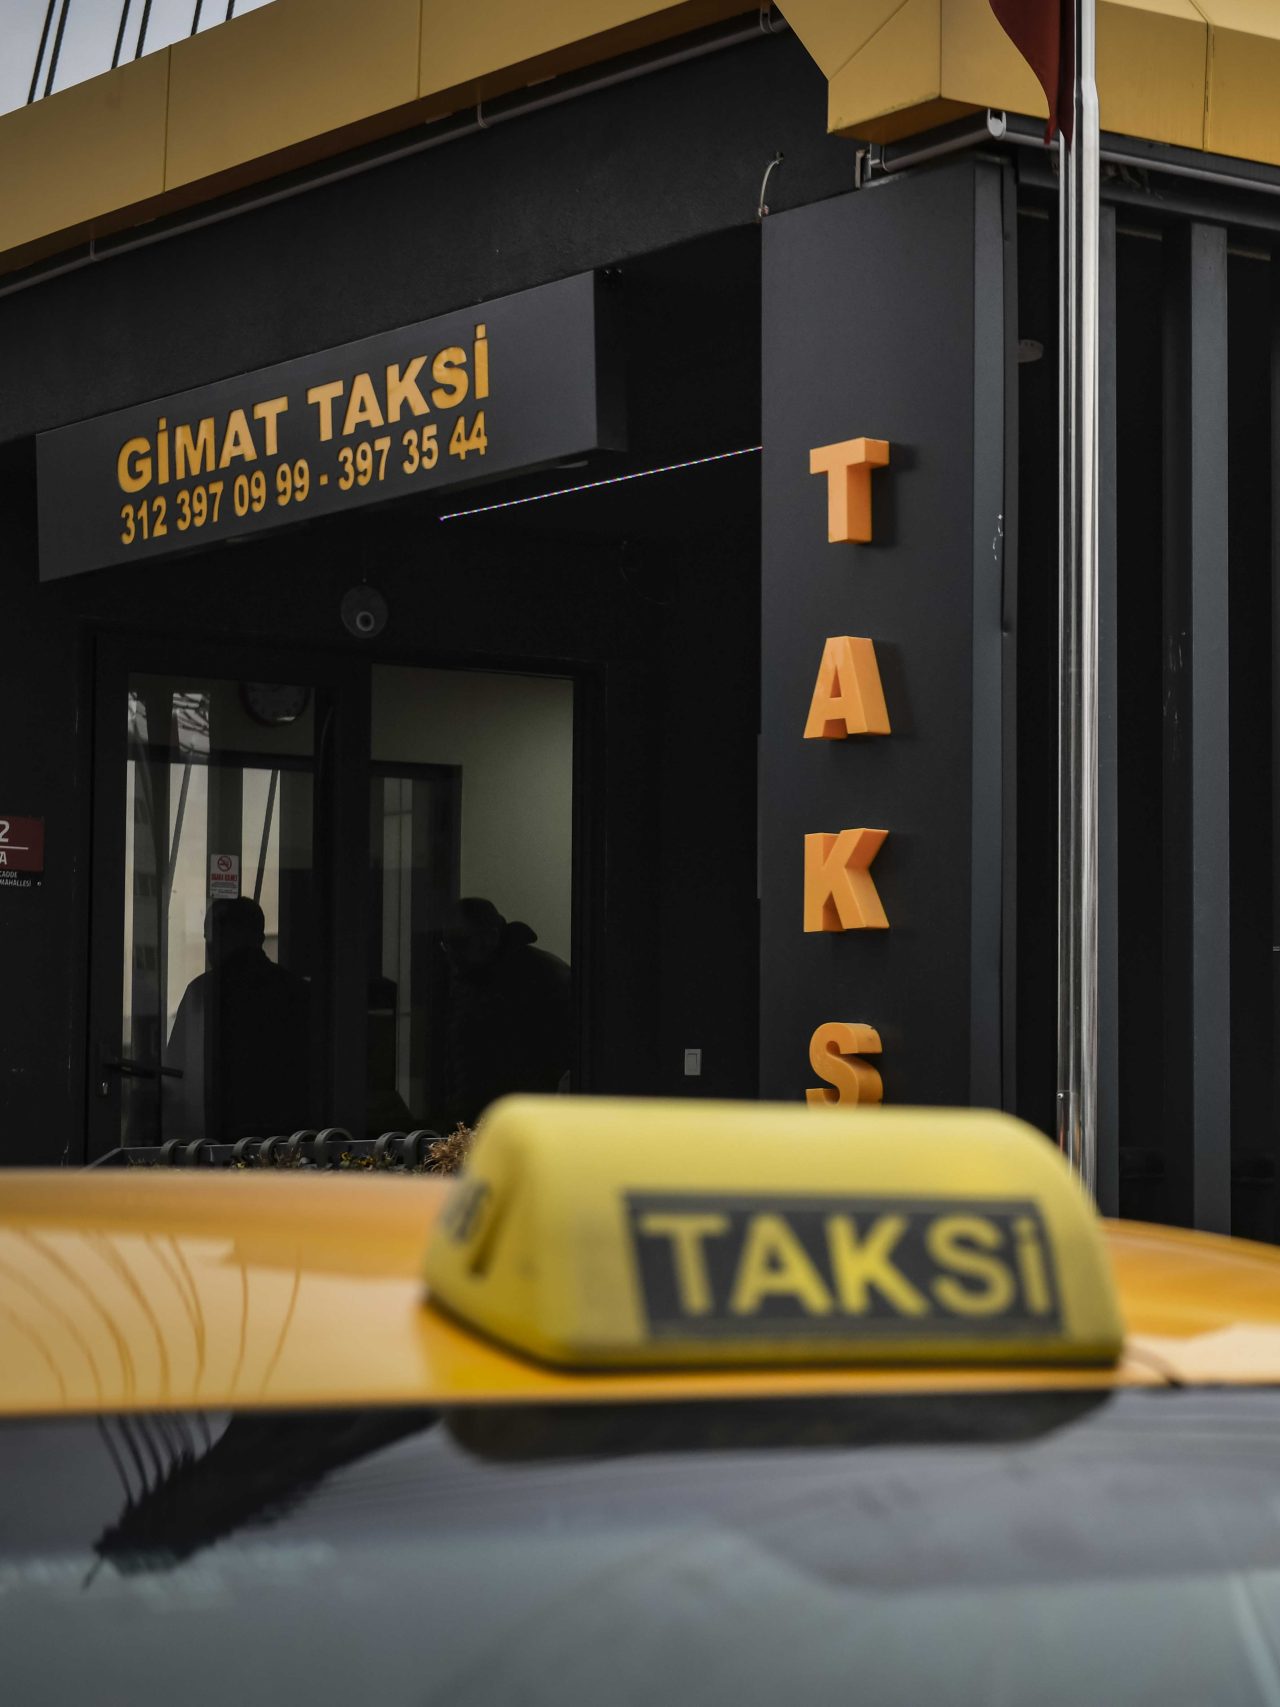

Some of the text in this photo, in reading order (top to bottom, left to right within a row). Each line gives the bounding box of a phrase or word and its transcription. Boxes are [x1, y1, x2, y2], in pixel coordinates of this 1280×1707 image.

[116, 323, 490, 494] GİMAT TAKSİ
[120, 410, 488, 546] 312 397 09 99 - 397 35 44
